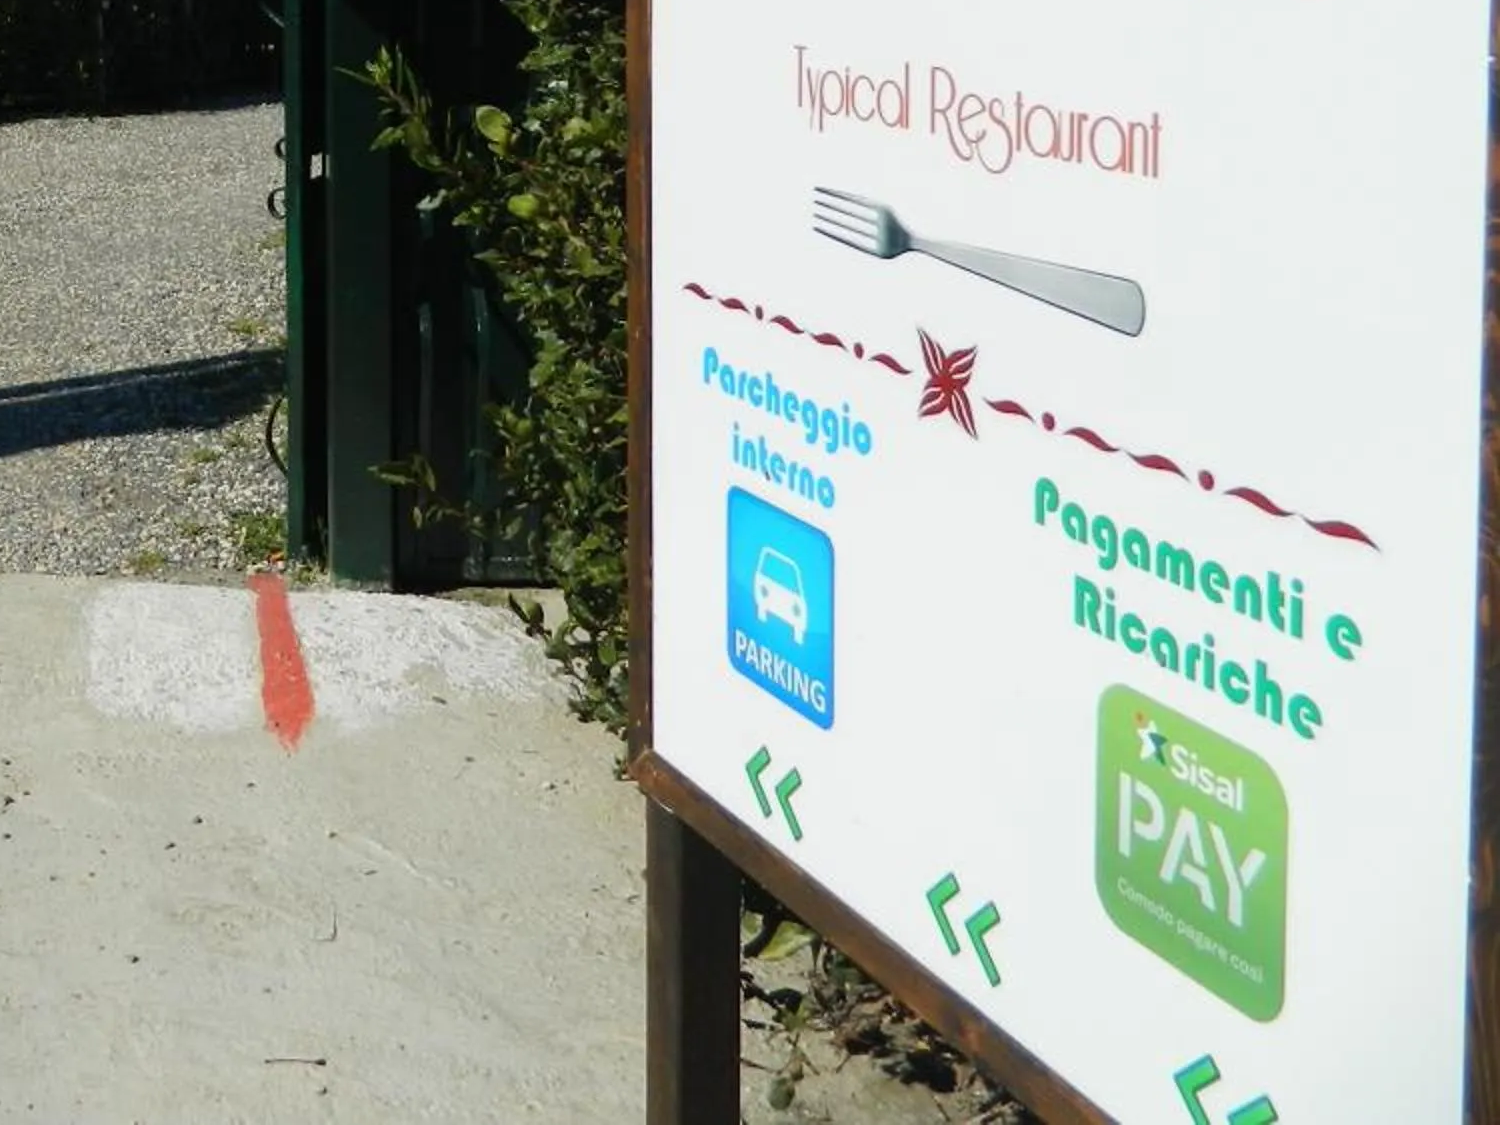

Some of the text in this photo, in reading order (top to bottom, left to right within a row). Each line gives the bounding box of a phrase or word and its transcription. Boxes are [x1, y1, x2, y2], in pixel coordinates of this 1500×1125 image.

[792, 44, 1163, 179] Typical Restaurant
[702, 346, 873, 456] Parcheggio
[731, 421, 836, 509] interno
[1034, 477, 1363, 661] Pagamenti e
[734, 628, 827, 714] PARKING
[1073, 574, 1324, 740] Ricariche
[1170, 742, 1245, 813] Sisal
[1118, 770, 1267, 928] PAY
